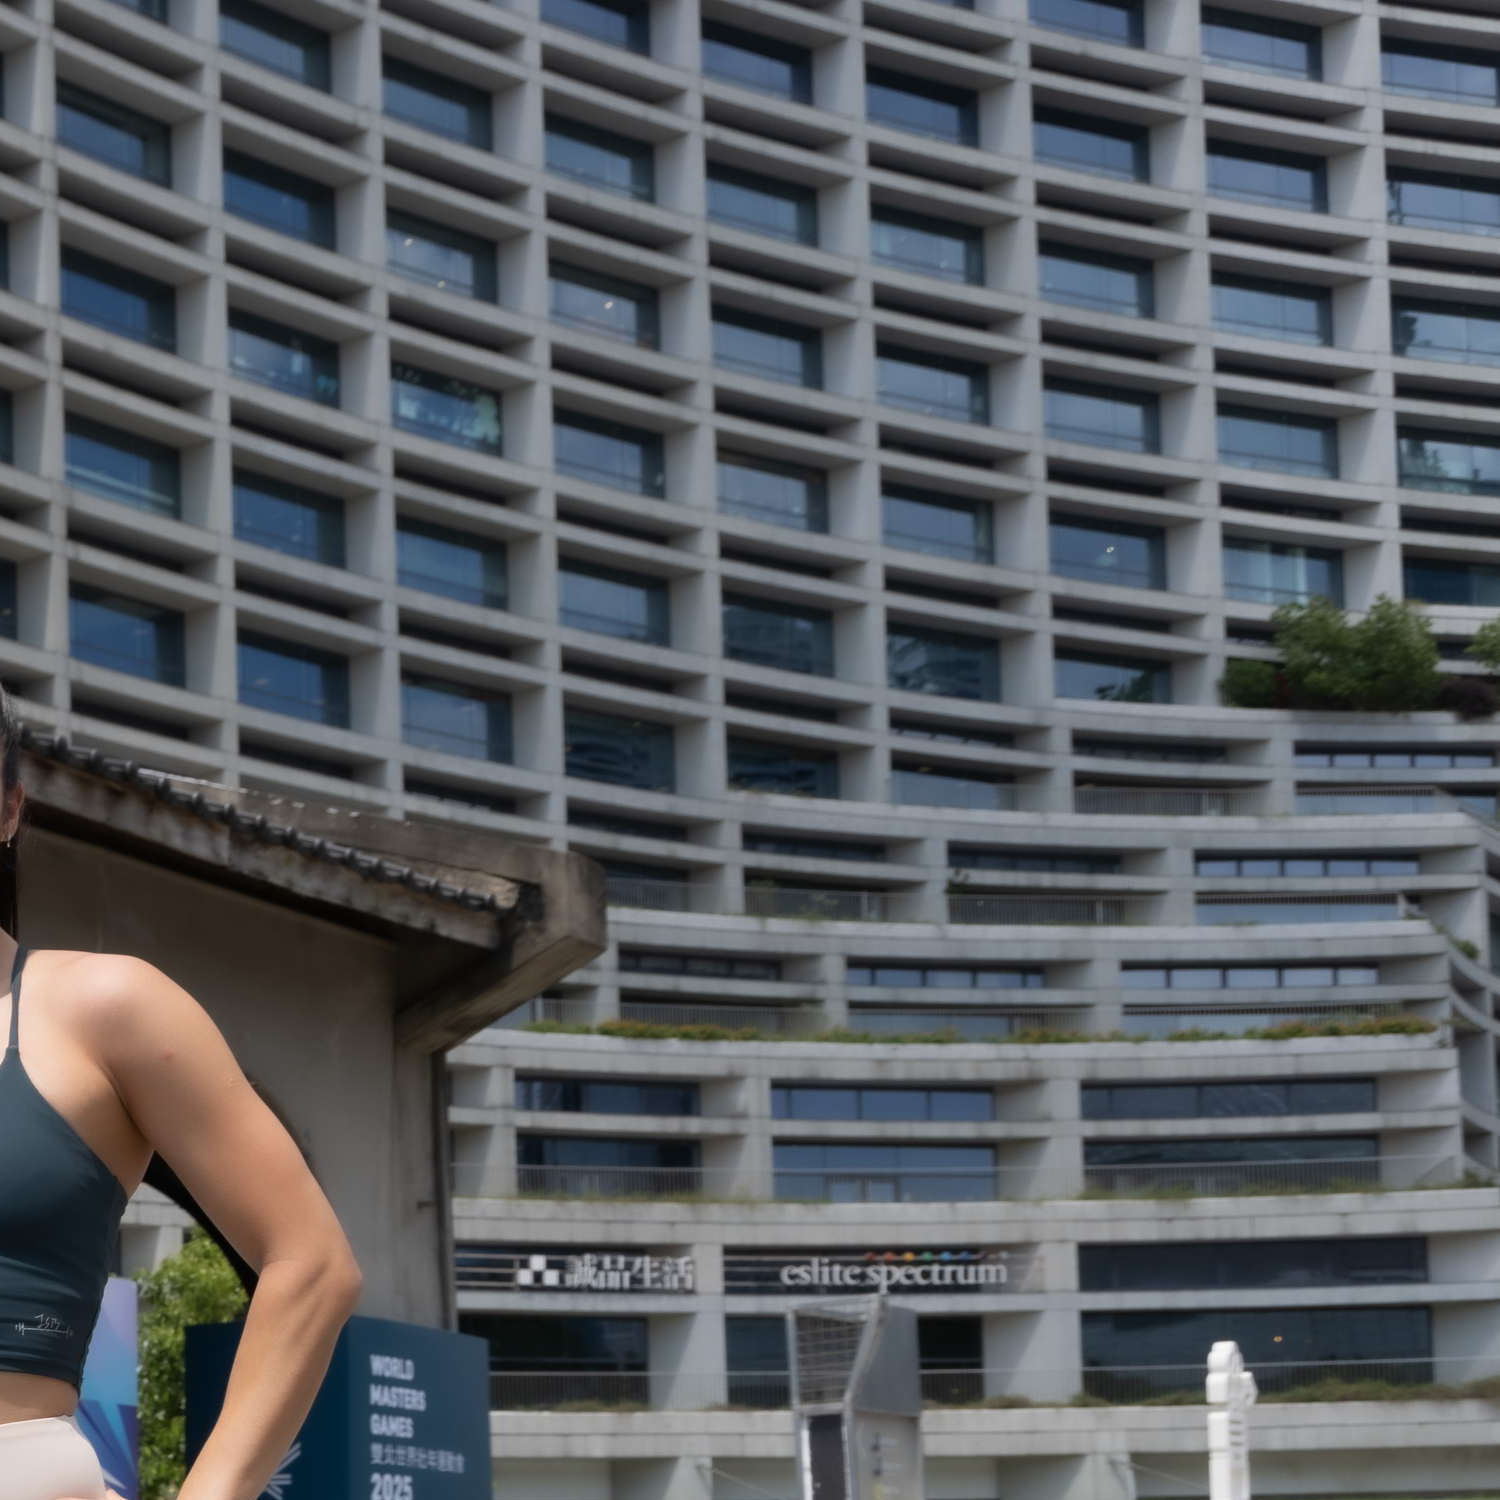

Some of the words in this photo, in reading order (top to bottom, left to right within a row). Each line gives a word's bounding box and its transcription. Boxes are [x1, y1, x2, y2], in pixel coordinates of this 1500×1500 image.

[564, 1252, 693, 1291] 誠品生活
[779, 1257, 861, 1286] eslite
[865, 1260, 1008, 1296] spectrum
[369, 1354, 414, 1381] WORLD
[369, 1384, 427, 1412] MASTERS
[370, 1413, 414, 1439] GAMES
